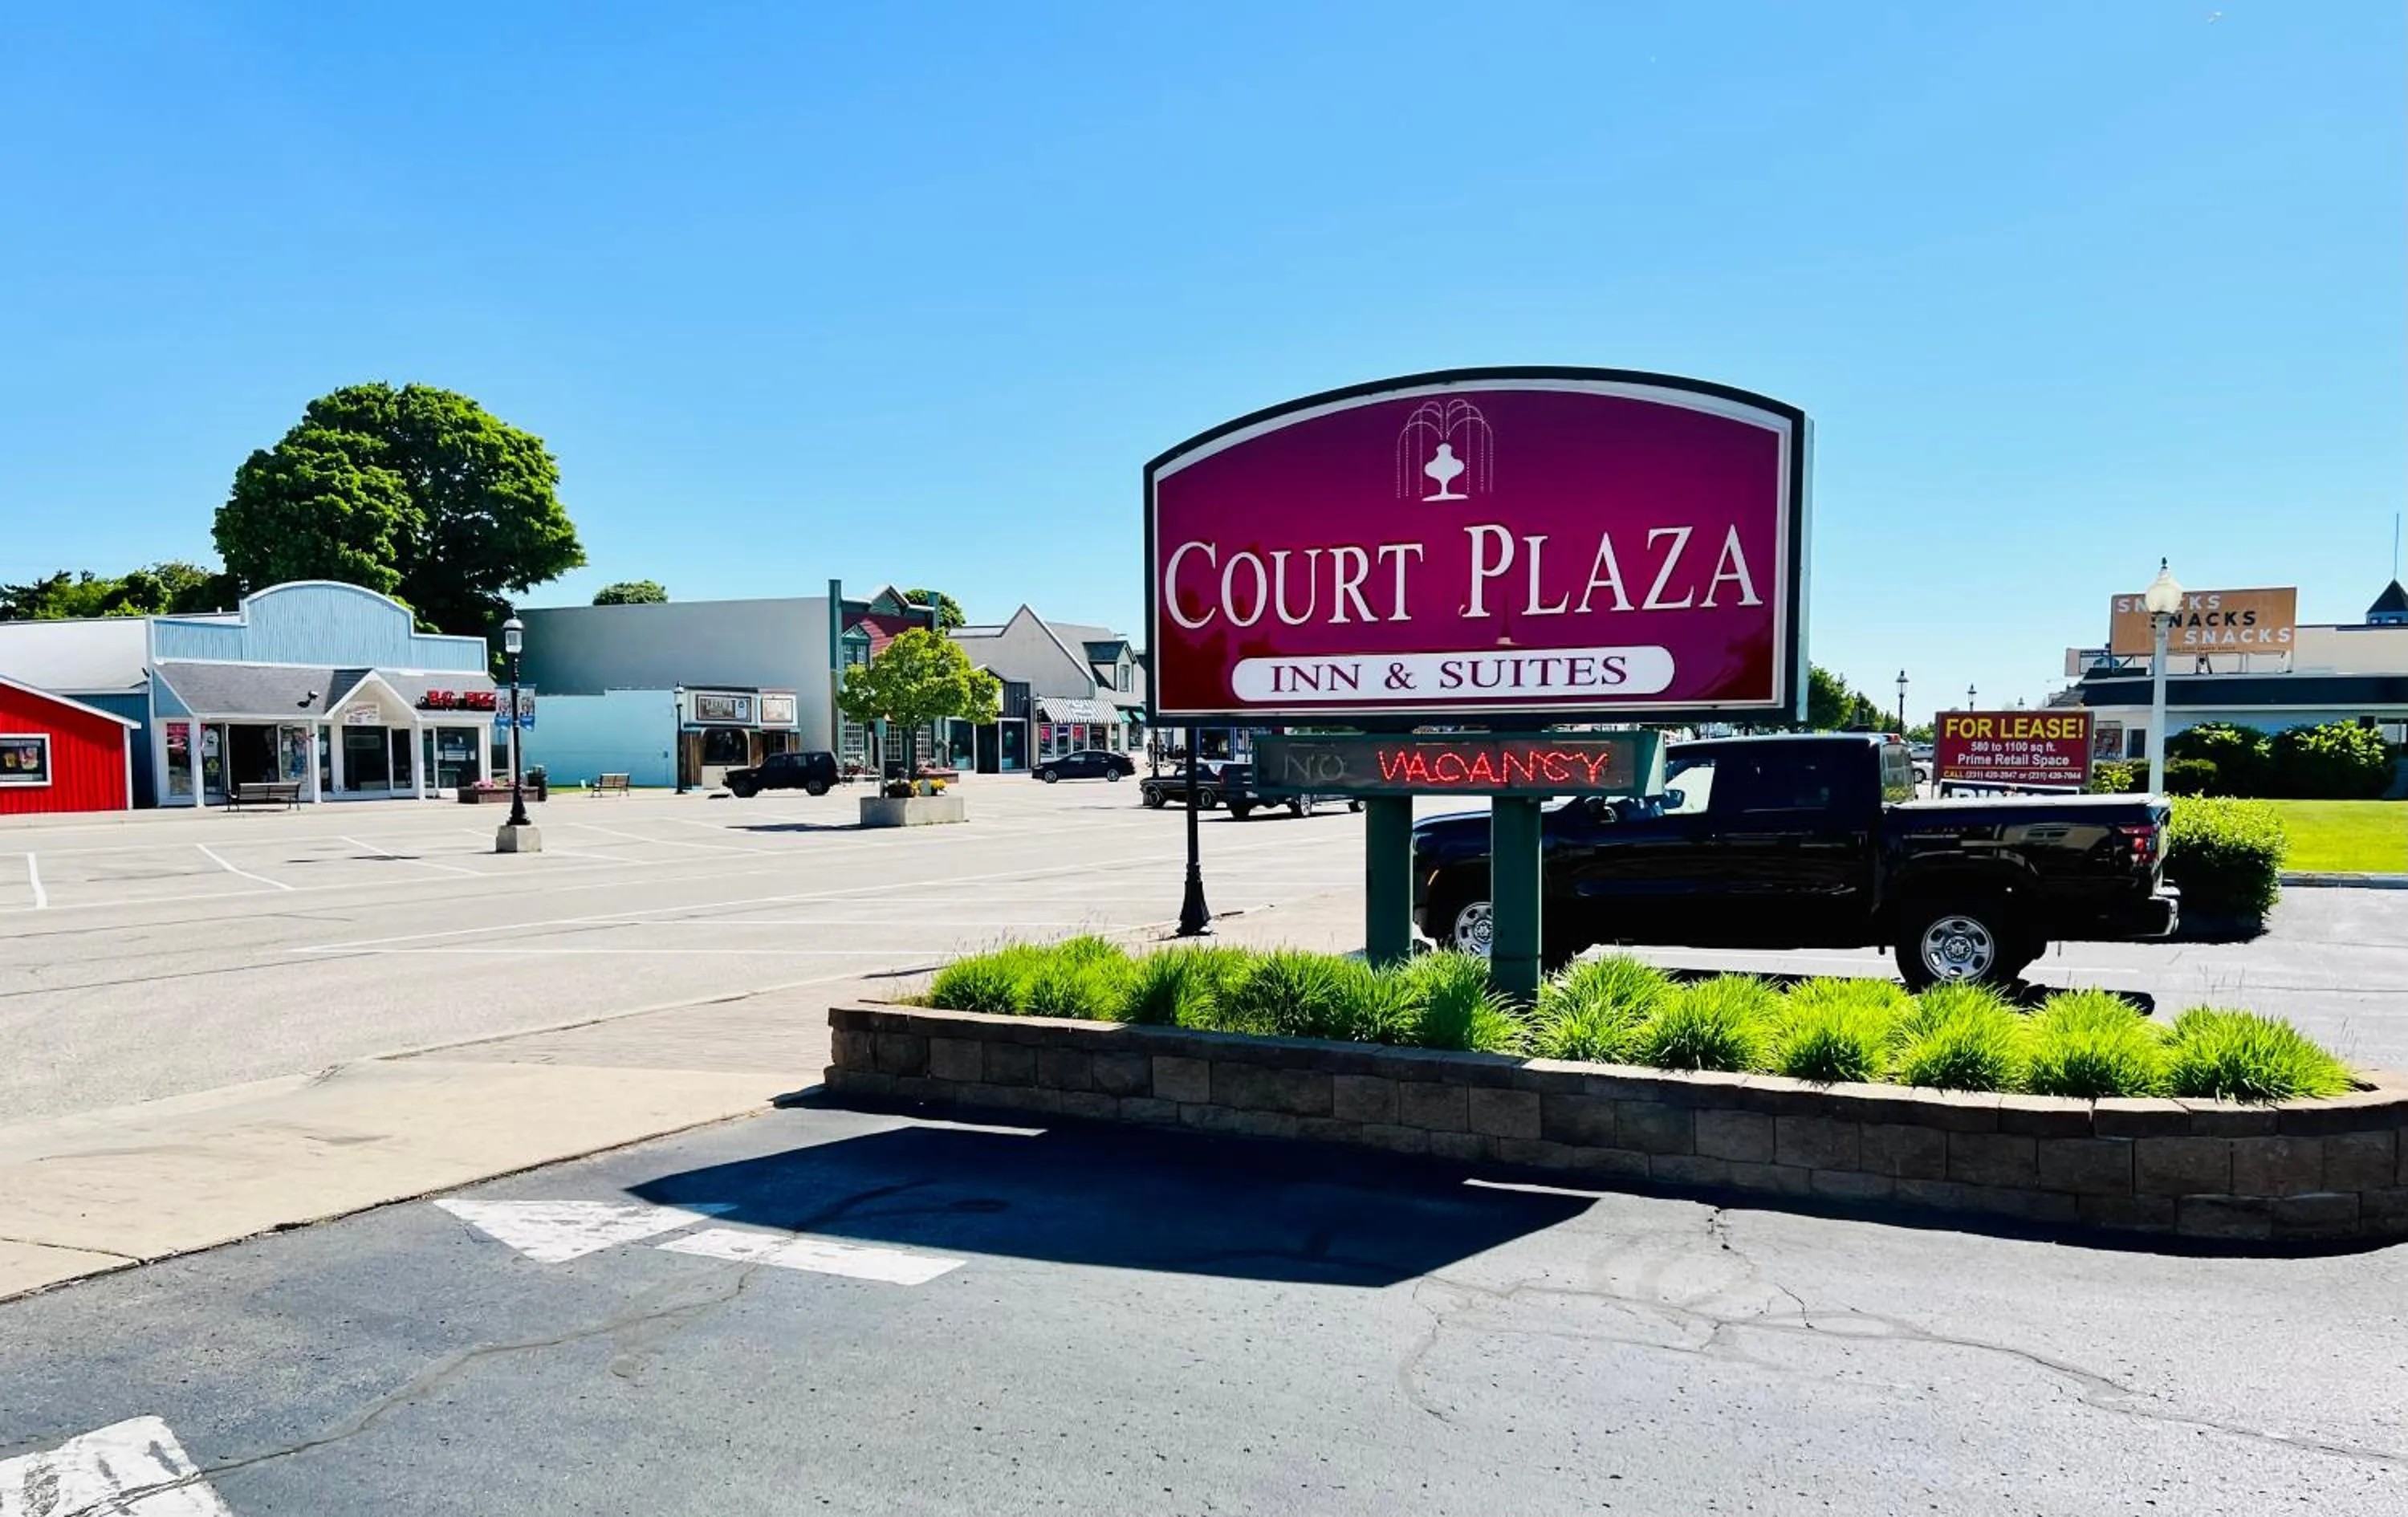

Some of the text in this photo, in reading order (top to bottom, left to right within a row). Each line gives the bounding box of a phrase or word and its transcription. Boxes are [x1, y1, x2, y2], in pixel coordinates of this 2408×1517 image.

[1165, 523, 1763, 628] COURT PLAZA
[2117, 595, 2222, 612] SNKS
[2183, 628, 2292, 645] SNACKS
[1271, 655, 1628, 693] INN & SUITES
[1945, 718, 2085, 739] FOR LEASE!
[1991, 742, 2003, 752] to
[2005, 741, 2028, 752] 1100
[2030, 743, 2043, 754] sq
[2046, 741, 2056, 752] ft.
[1283, 749, 1609, 784] NO VACANCY
[1958, 753, 2070, 767] Prime Retail Space
[1943, 771, 1963, 779] CALL
